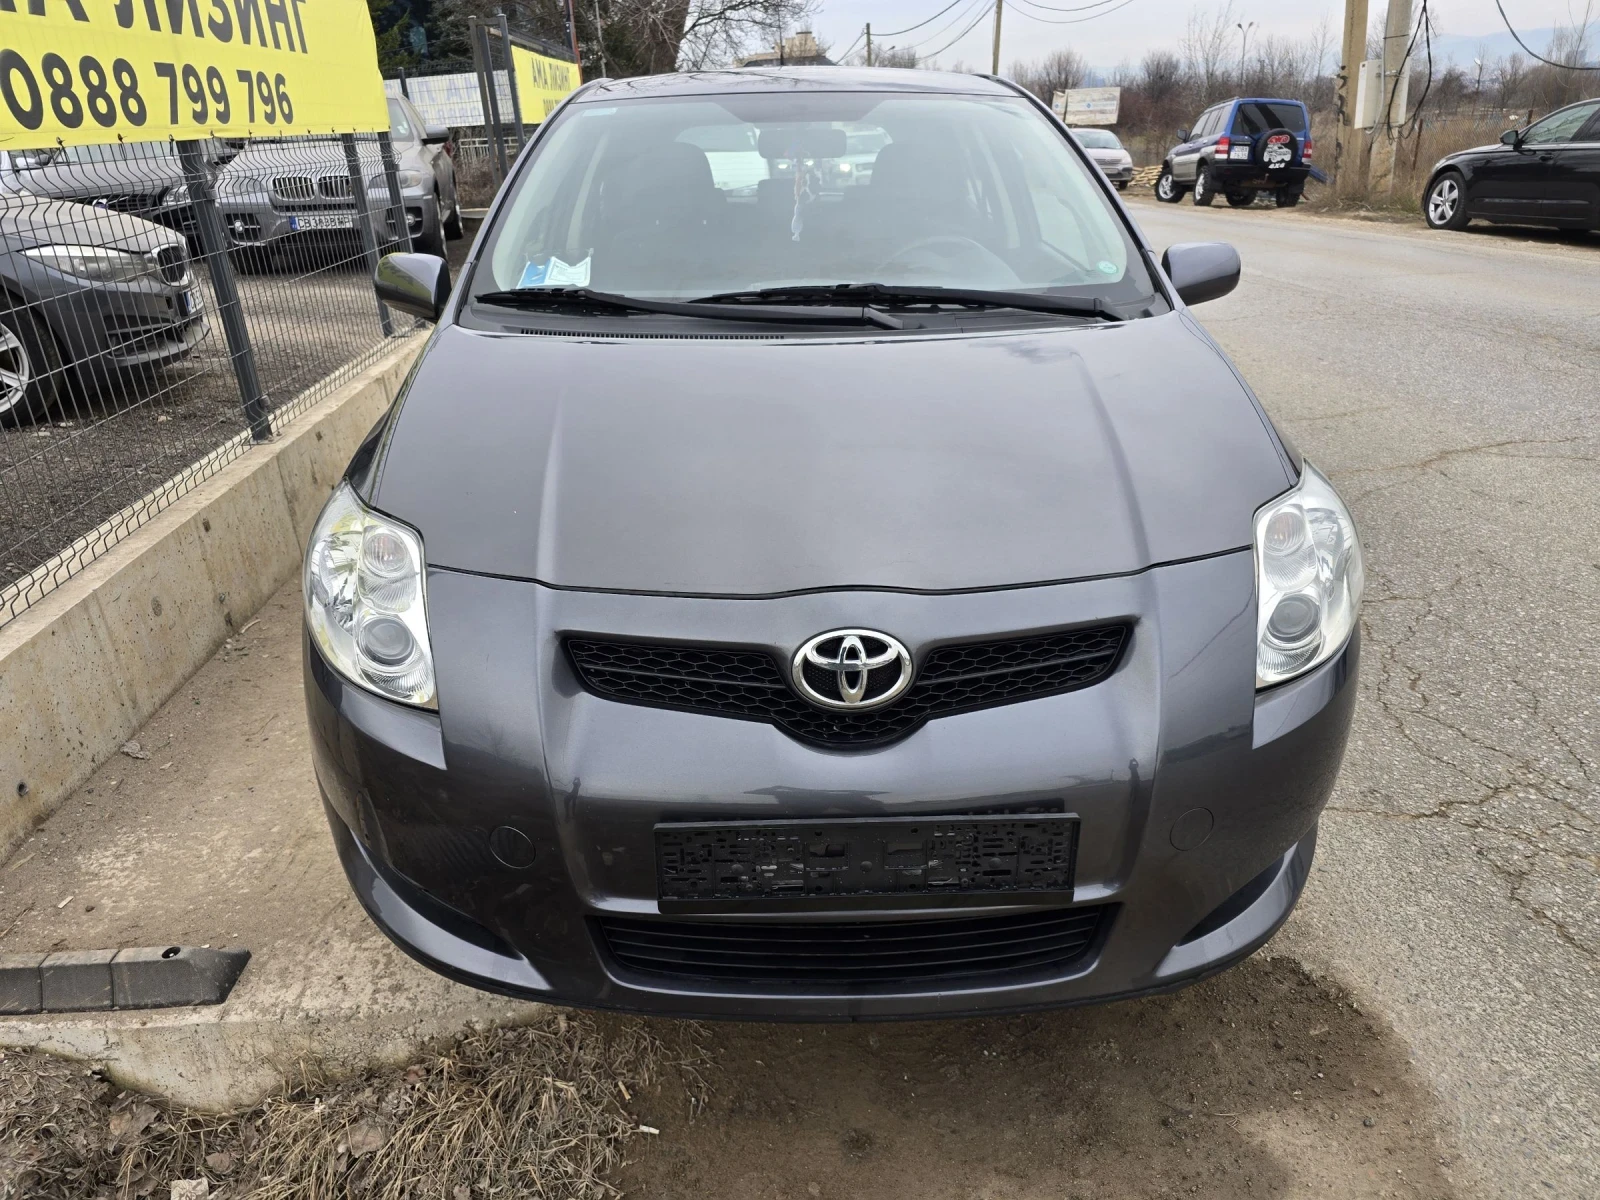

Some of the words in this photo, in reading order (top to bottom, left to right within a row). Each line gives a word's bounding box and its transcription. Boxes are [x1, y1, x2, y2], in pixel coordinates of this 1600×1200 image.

[0, 48, 147, 130] 0888
[153, 61, 231, 125] 799
[236, 69, 294, 125] 796
